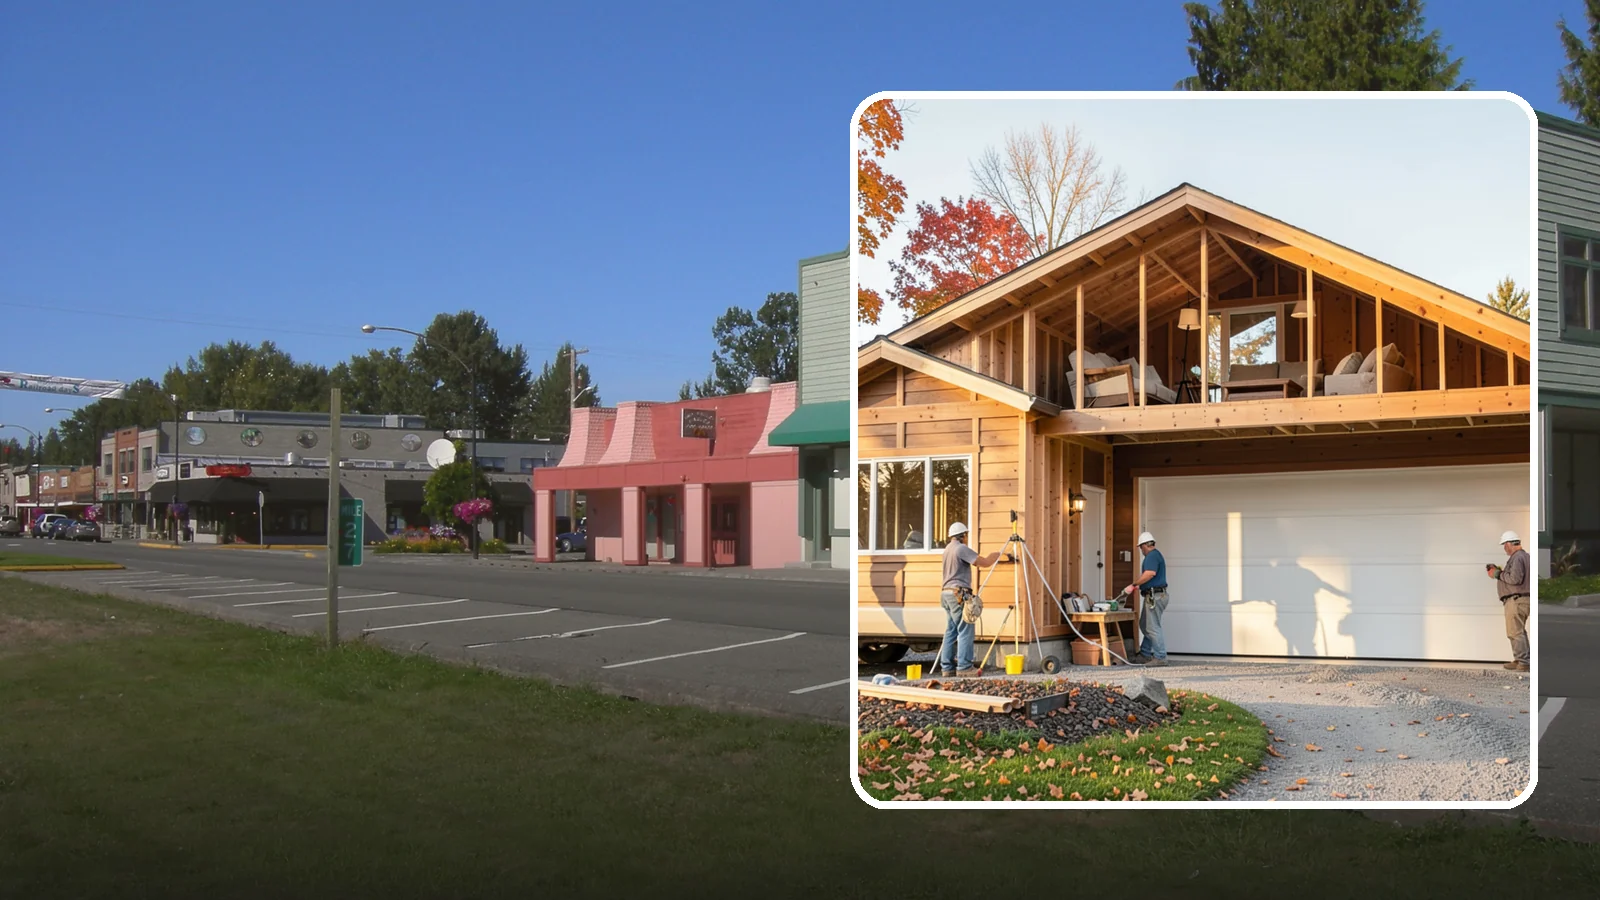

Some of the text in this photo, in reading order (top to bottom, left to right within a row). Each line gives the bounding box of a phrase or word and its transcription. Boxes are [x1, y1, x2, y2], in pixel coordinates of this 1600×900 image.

[20, 379, 56, 392] Railroad
[341, 505, 362, 517] MILE
[344, 522, 357, 539] 2
[344, 543, 356, 559] 7
